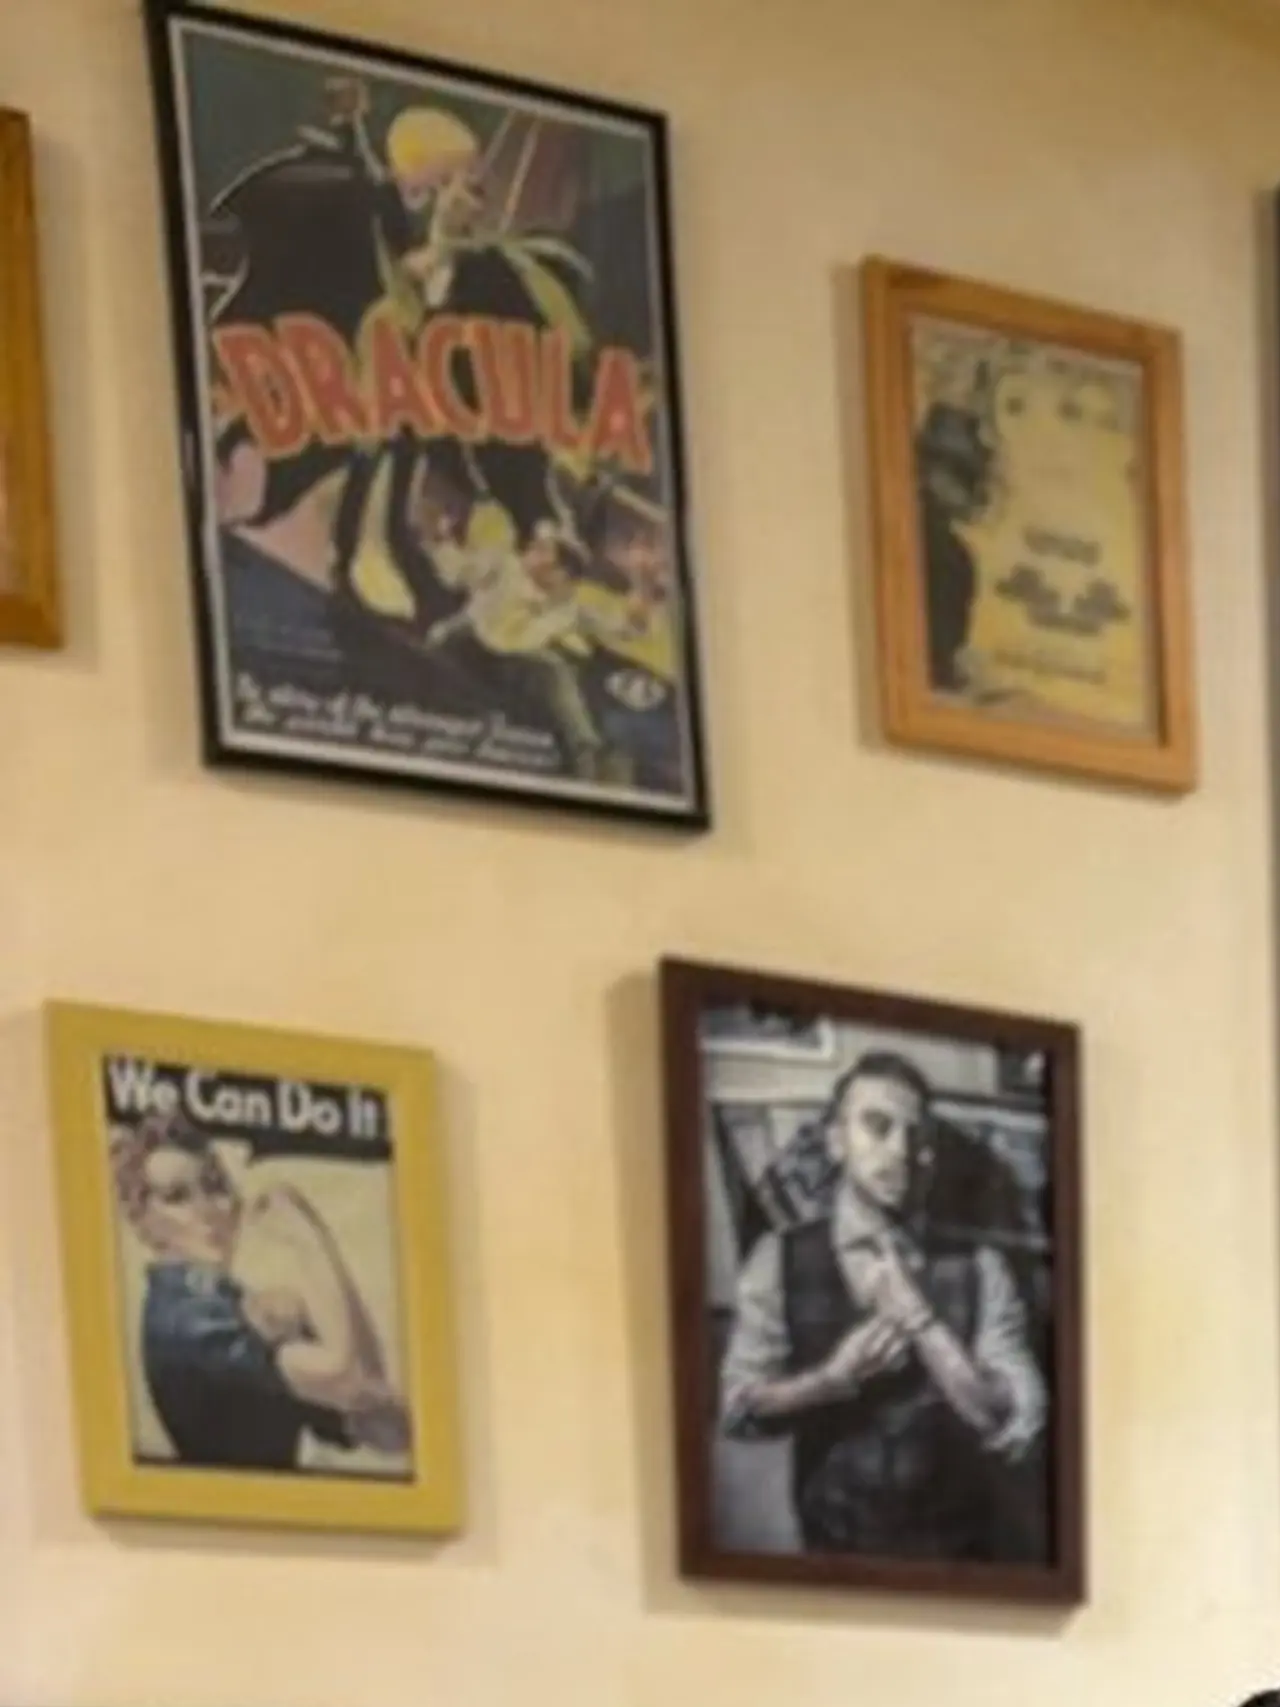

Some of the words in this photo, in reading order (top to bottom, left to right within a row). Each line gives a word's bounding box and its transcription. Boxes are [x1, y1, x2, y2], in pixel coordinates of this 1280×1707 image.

[213, 312, 652, 475] DRACULA
[108, 1053, 179, 1114] We
[185, 1069, 272, 1127] Can
[278, 1078, 341, 1135] Do
